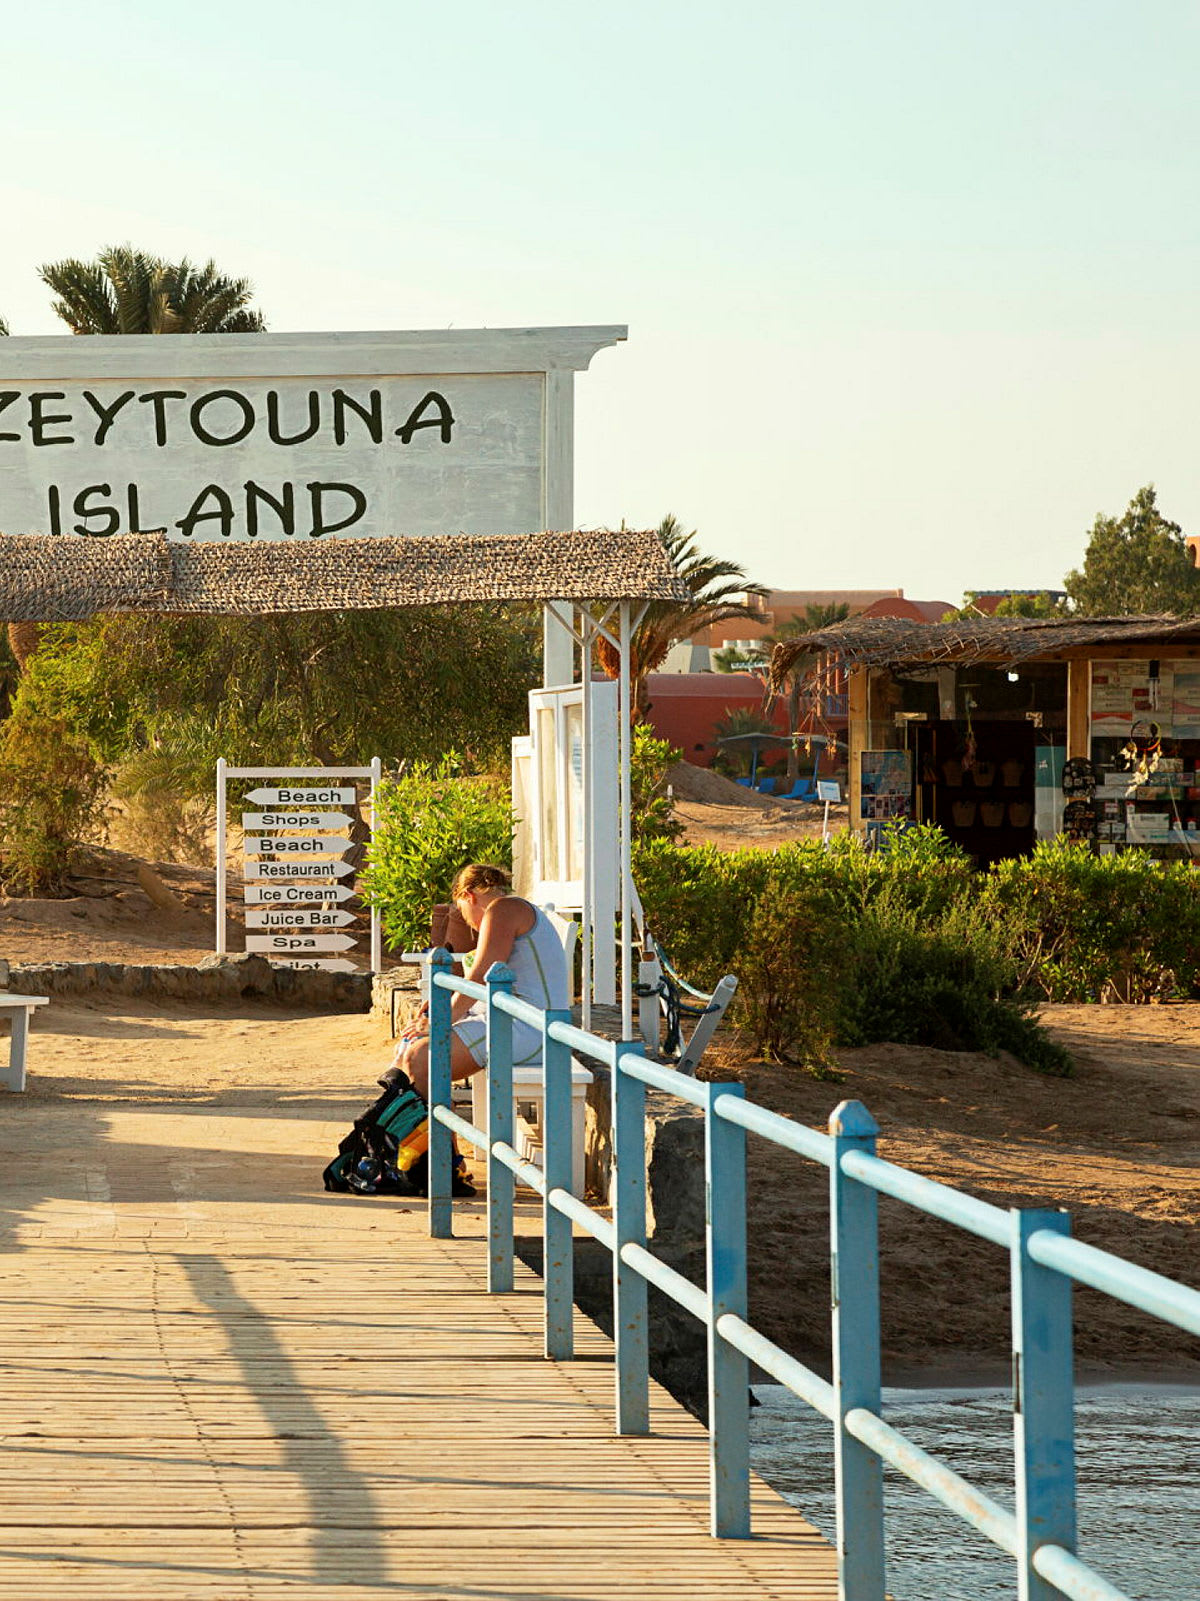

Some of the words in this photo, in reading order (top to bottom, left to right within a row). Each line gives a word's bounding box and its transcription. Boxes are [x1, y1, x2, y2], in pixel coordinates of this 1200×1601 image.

[48, 480, 367, 538] ISLAND
[278, 789, 342, 803] Beach
[261, 815, 320, 828] Shops
[260, 839, 324, 852] Beach
[259, 864, 335, 876] Restaurant
[259, 888, 282, 901] Ice
[287, 888, 338, 901] Cream
[261, 912, 305, 926] Juice
[310, 912, 339, 925] Bar
[273, 937, 316, 950] Spa
